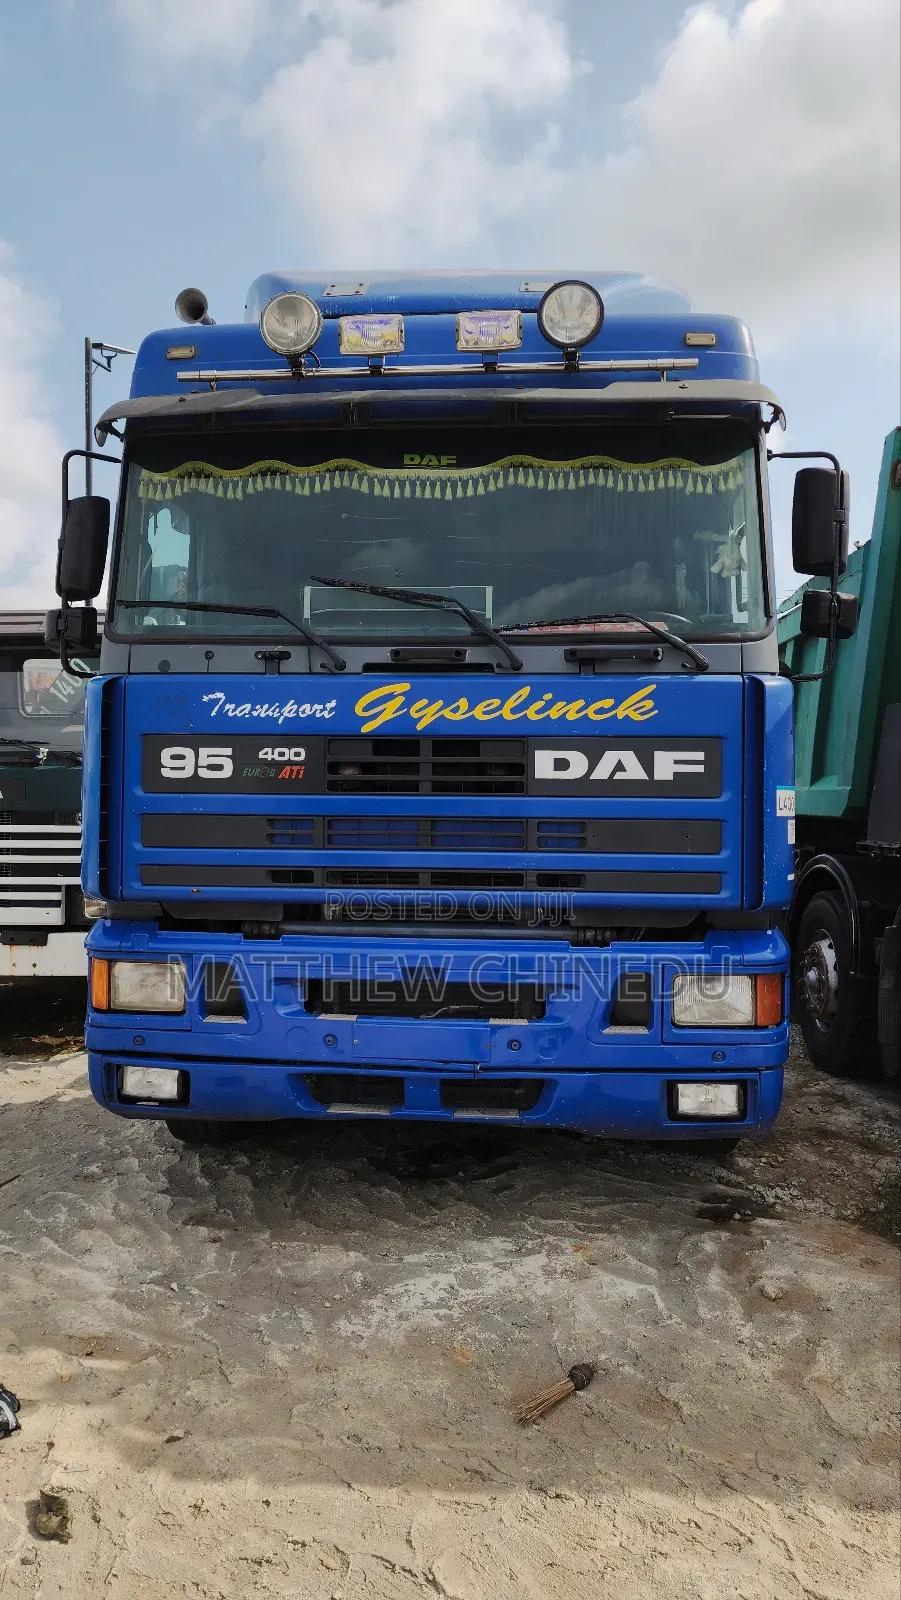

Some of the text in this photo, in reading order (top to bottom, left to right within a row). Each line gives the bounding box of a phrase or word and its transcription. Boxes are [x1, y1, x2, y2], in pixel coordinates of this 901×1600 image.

[403, 453, 457, 466] DAF
[202, 692, 337, 724] Transport
[354, 682, 659, 733] Gyselinck
[160, 746, 234, 779] 95
[258, 747, 306, 761] 400
[534, 750, 705, 781] DAF
